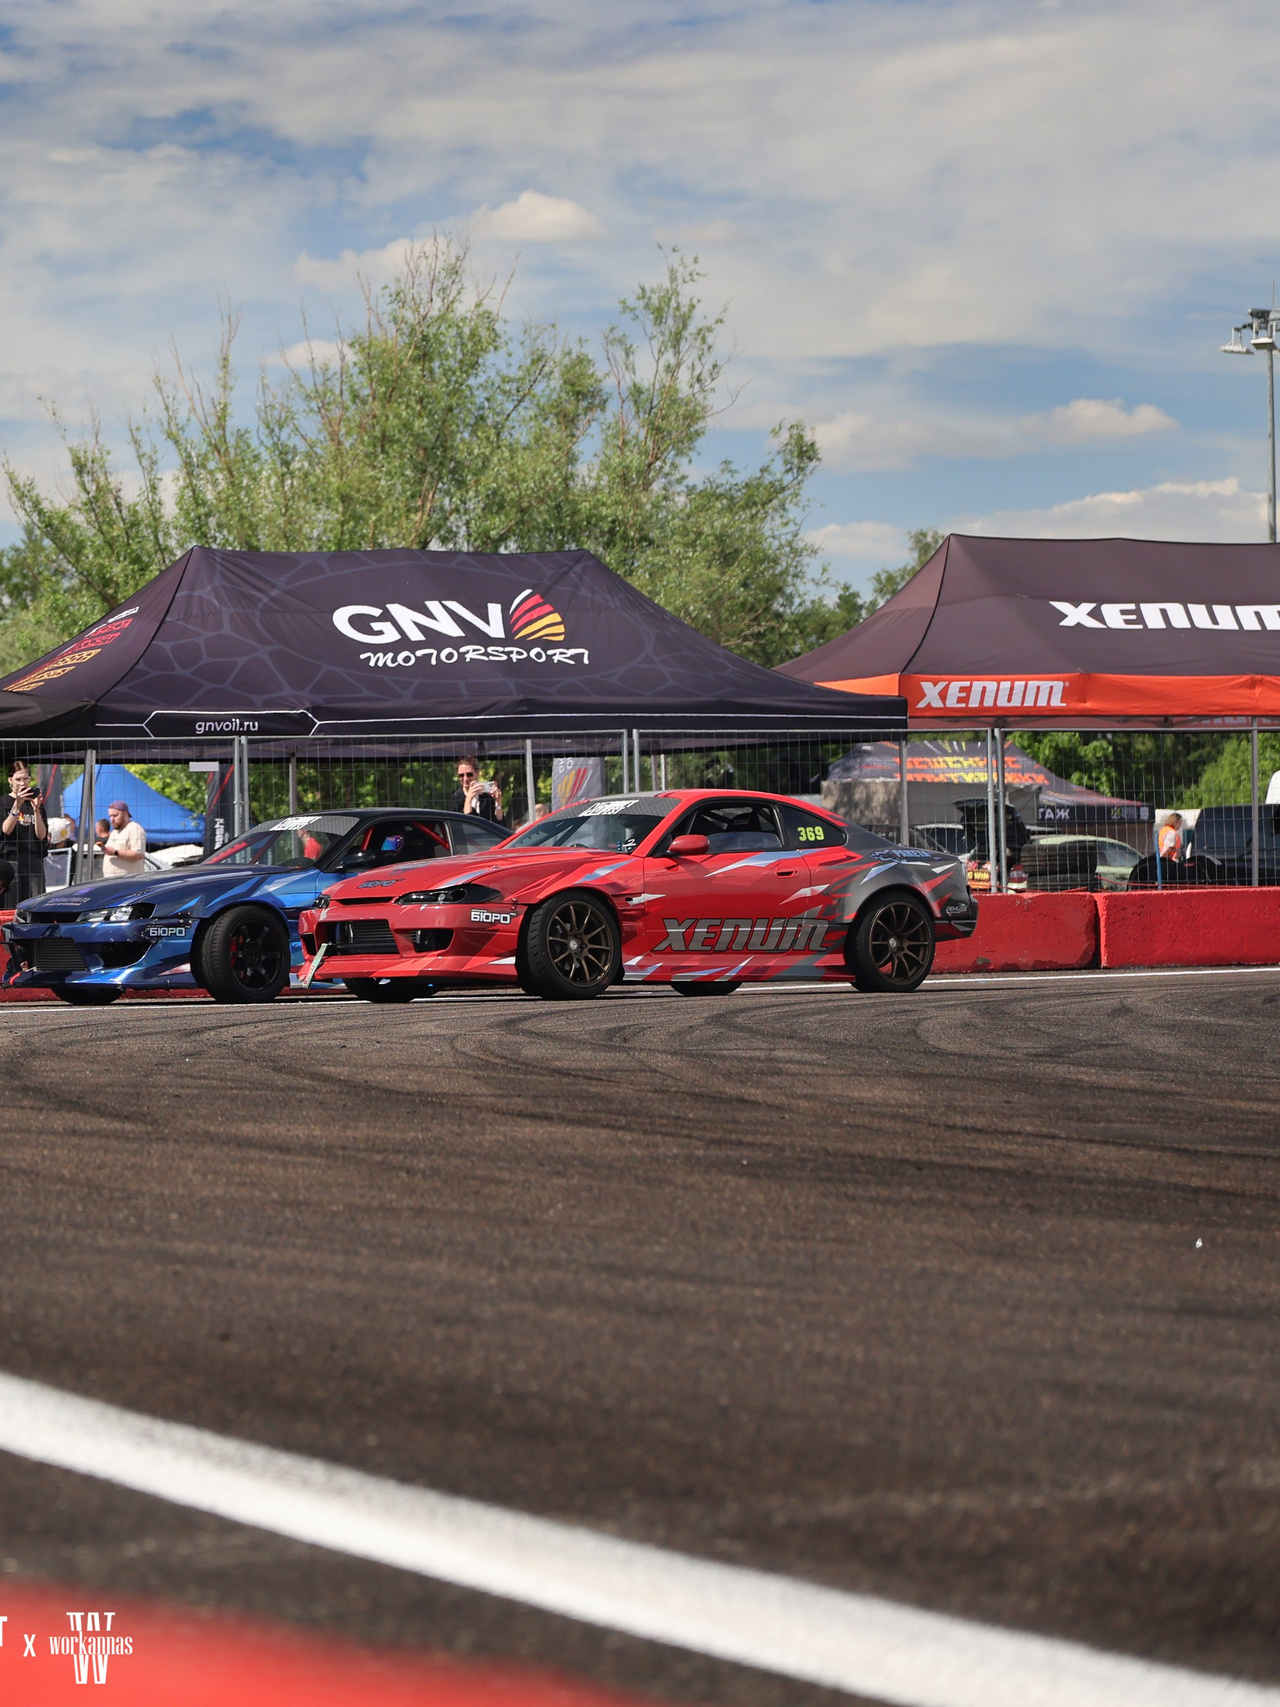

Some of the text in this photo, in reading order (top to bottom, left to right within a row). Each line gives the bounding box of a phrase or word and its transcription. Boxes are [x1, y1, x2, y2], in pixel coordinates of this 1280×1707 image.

[332, 600, 506, 644] GNV
[1049, 600, 1280, 631] XENUM
[360, 645, 589, 668] MOTORSPORT
[915, 680, 1067, 709] XENUM
[195, 718, 259, 734] gnvoil.ru
[797, 826, 825, 842] 369
[470, 911, 511, 924] БЮРО
[149, 927, 186, 937] БЮРО
[651, 917, 830, 954] XENUM
